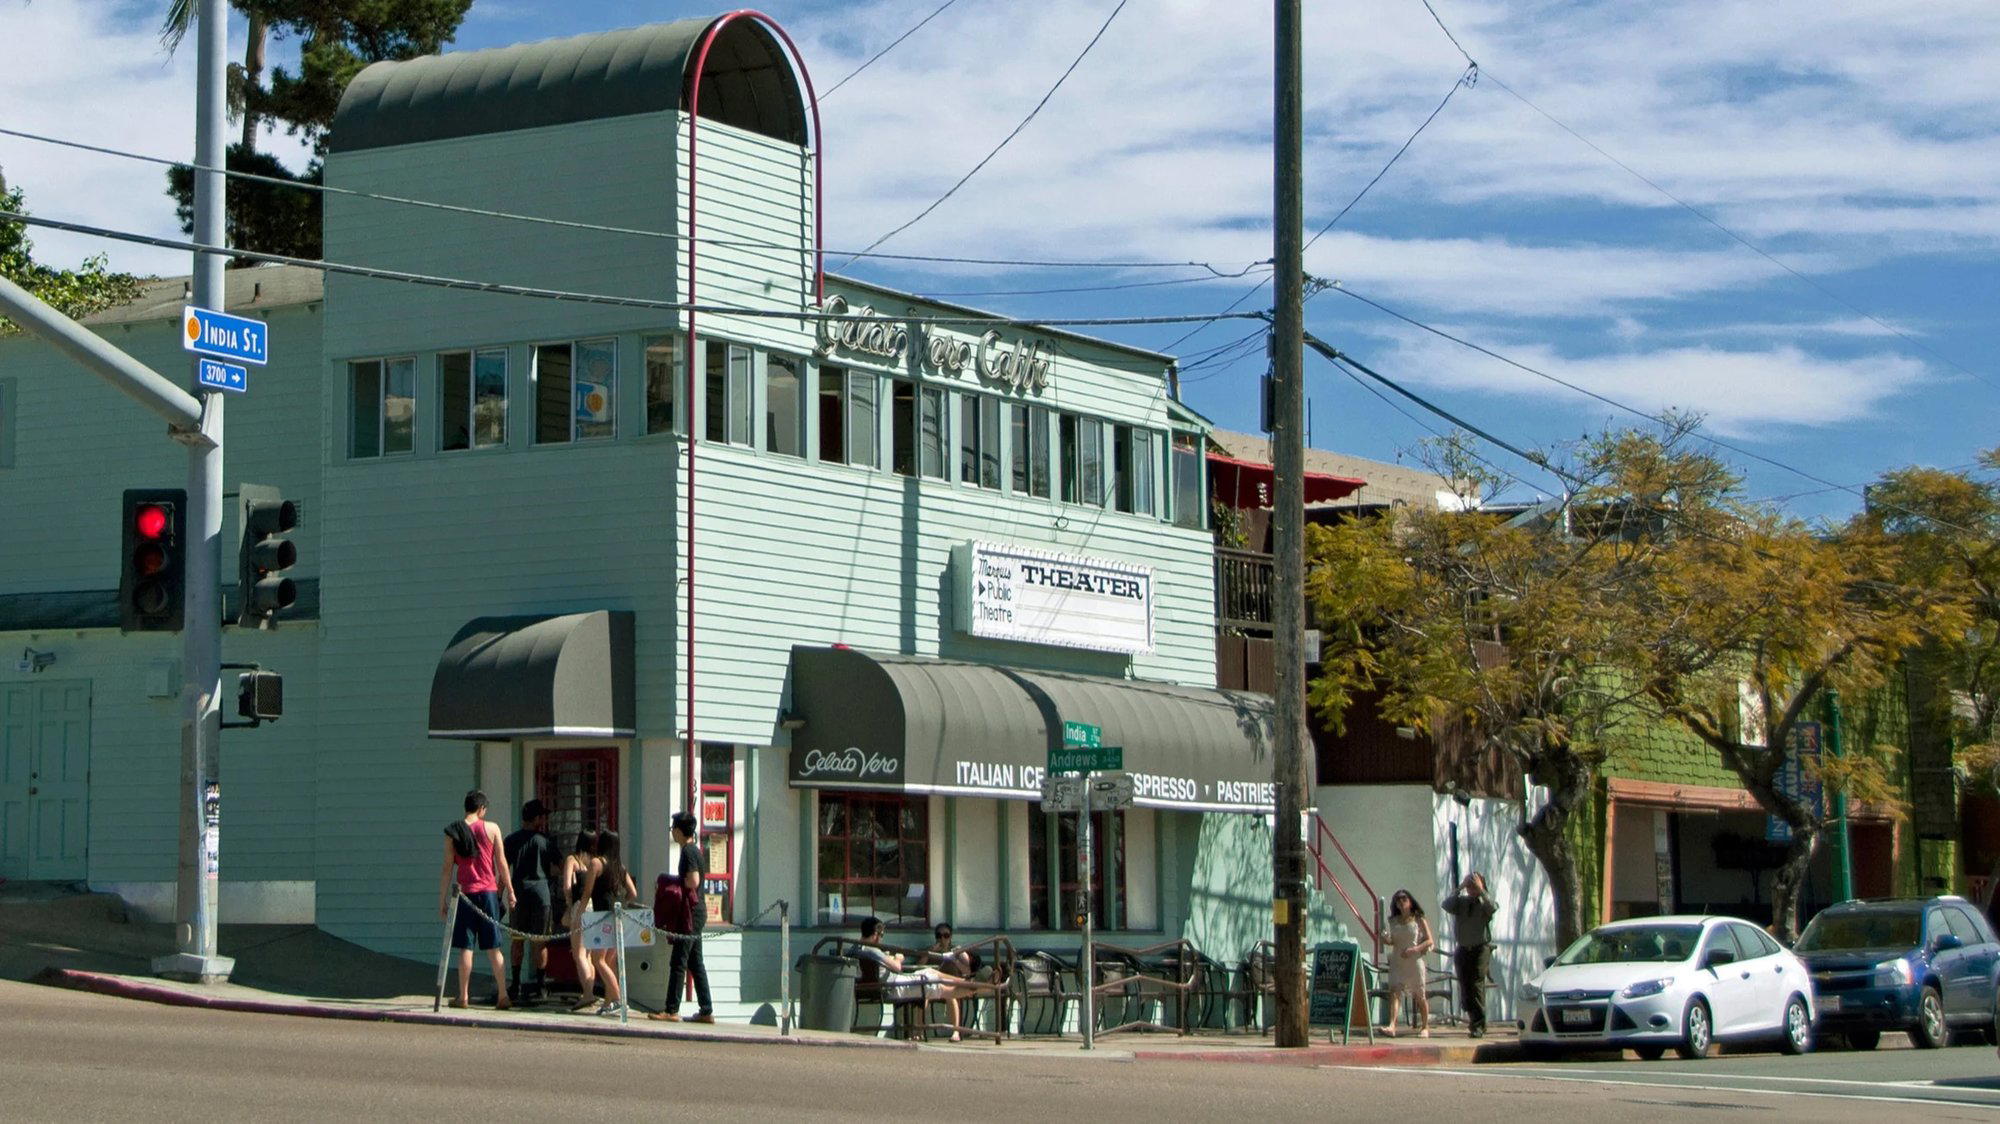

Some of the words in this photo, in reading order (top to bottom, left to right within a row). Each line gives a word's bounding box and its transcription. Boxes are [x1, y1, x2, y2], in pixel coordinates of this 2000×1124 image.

[204, 319, 238, 350] INDIA
[814, 294, 909, 358] Gelato
[206, 364, 227, 384] 3700
[987, 580, 1012, 601] Public
[1021, 564, 1143, 601] THEATER
[979, 601, 1012, 623] Theatre
[1066, 723, 1087, 742] India
[799, 748, 857, 776] Gelato
[844, 747, 899, 778] Vero
[1050, 752, 1098, 769] Andrews
[956, 761, 1013, 788] ITALIAN
[1019, 765, 1044, 789] ICE
[1126, 772, 1197, 801] SPRESSO
[1217, 780, 1275, 804] PASTRIES
[704, 801, 726, 822] OPEN
